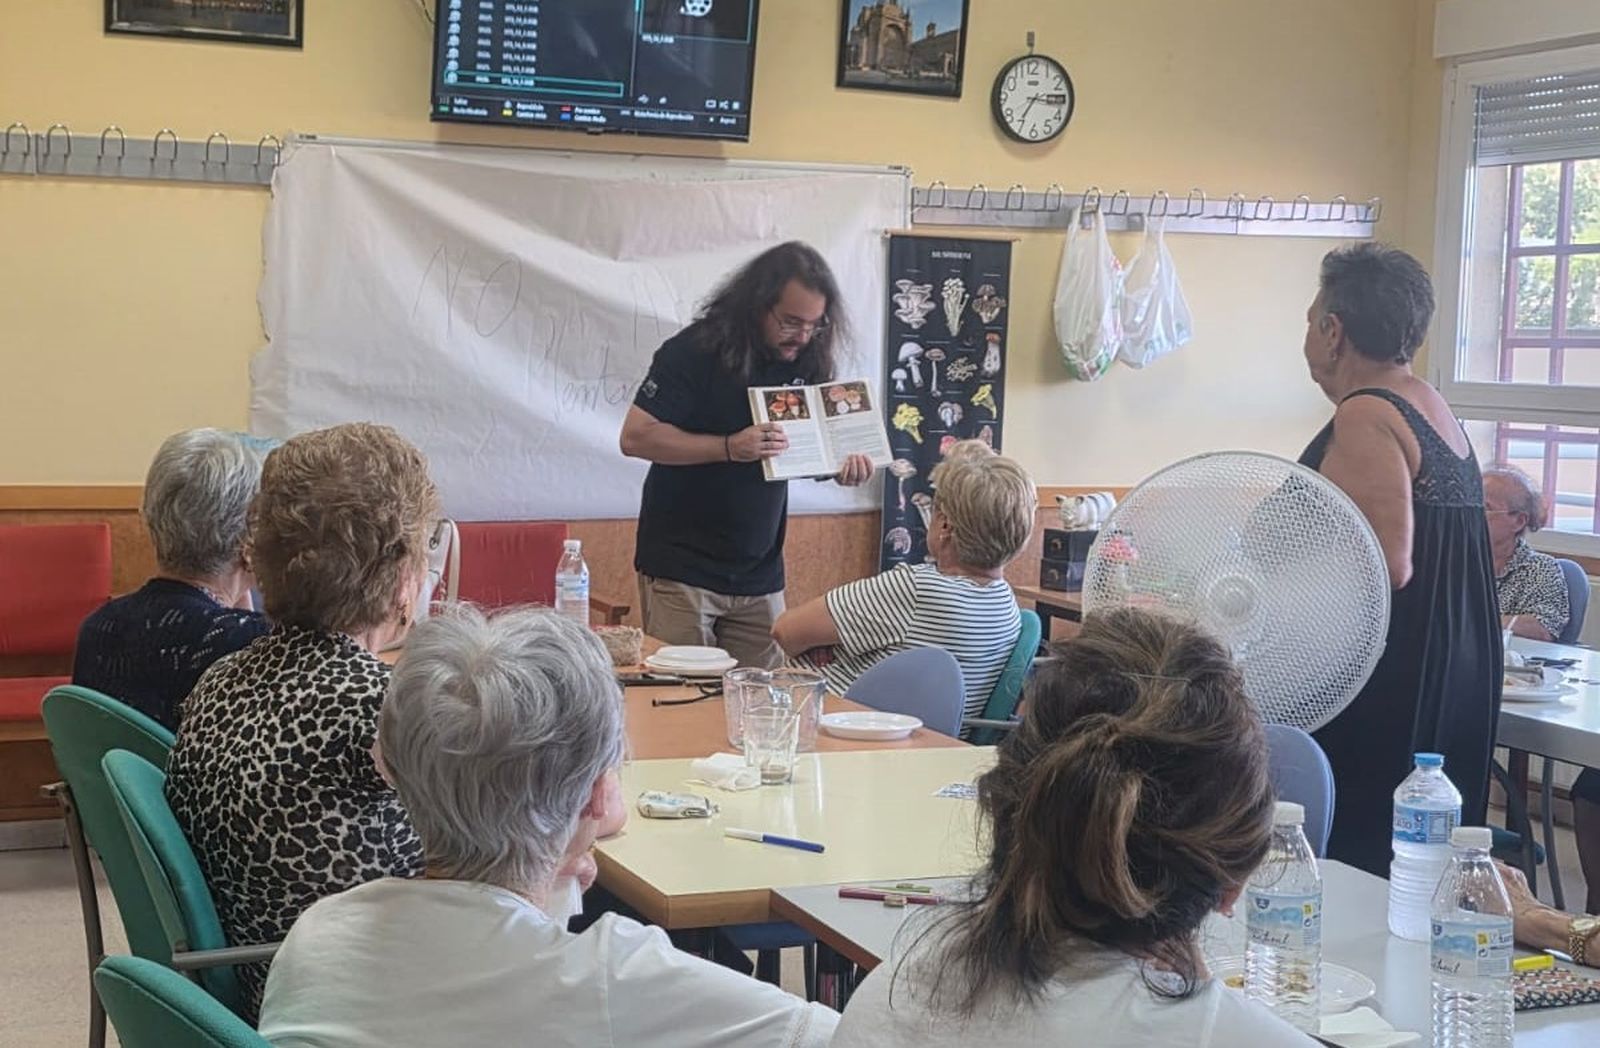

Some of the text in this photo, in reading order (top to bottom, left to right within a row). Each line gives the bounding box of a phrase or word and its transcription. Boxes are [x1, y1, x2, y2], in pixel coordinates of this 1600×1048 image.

[1027, 60, 1039, 75] 12
[1053, 74, 1063, 91] 2
[1005, 107, 1014, 123] 8
[1053, 108, 1062, 122] 4
[1017, 119, 1025, 134] 7
[1029, 122, 1039, 139] 6
[1043, 118, 1053, 135] 5
